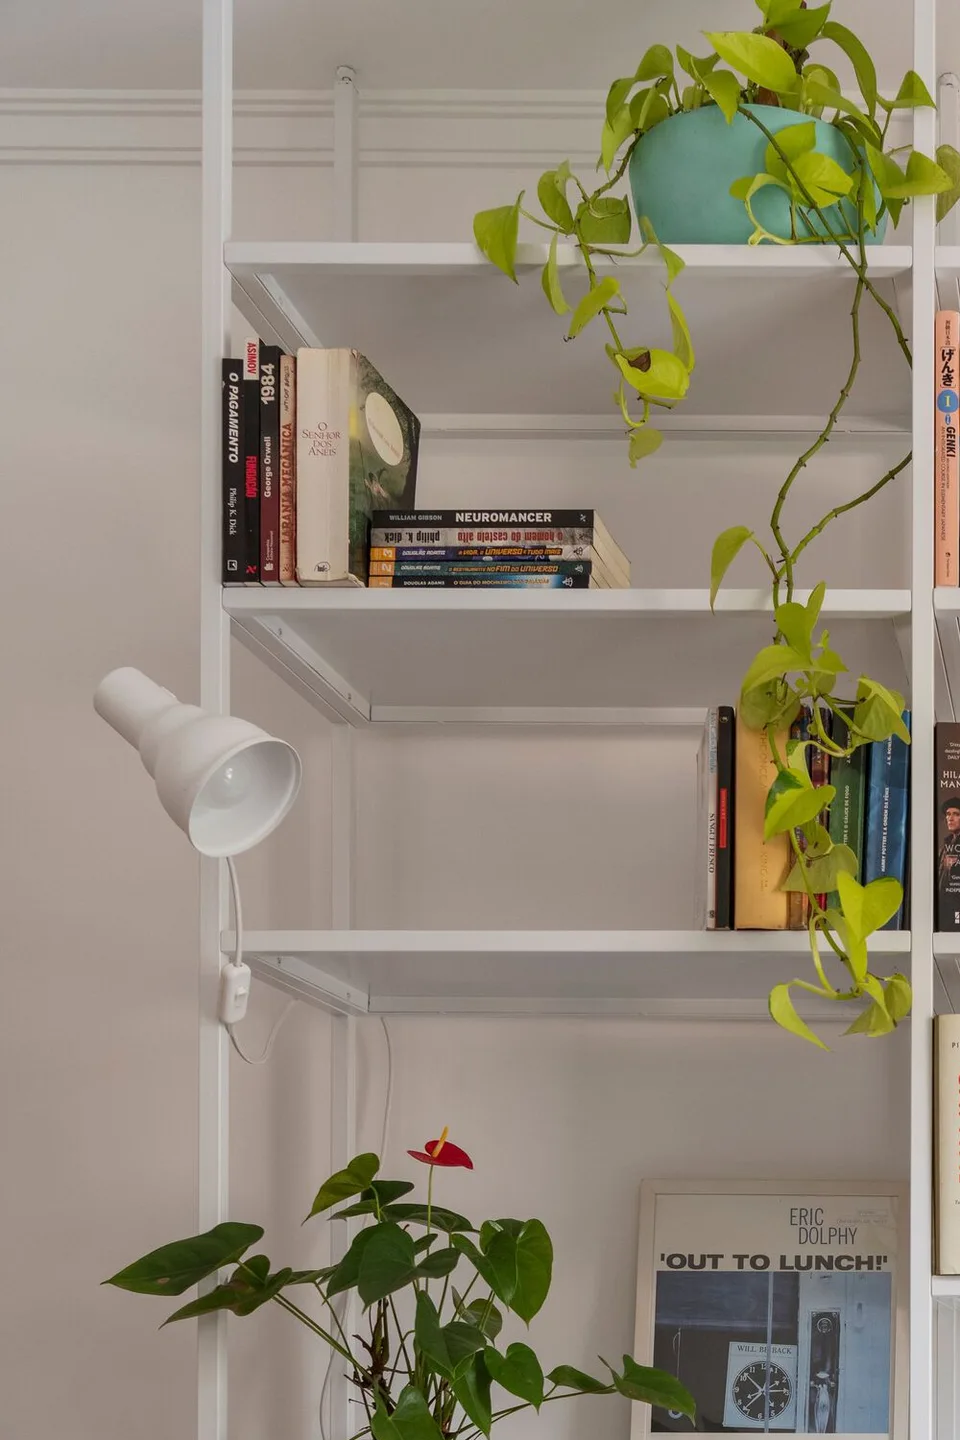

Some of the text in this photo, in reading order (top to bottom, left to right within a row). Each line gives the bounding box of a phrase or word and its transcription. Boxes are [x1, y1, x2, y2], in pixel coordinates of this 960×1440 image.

[247, 342, 257, 374] ASIMOV
[260, 363, 275, 404] 1984
[228, 372, 239, 463] O PAGAMENTO
[946, 426, 956, 458] GENKI
[263, 436, 272, 497] George Orwell
[455, 512, 552, 523] NEUROMANCER
[790, 1208, 824, 1226] ERIC
[798, 1227, 858, 1245] DOLPHY
[660, 1253, 724, 1270] 'OUT
[732, 1254, 770, 1271] TO
[737, 1345, 756, 1353] WILL
[772, 1346, 792, 1354] BACK
